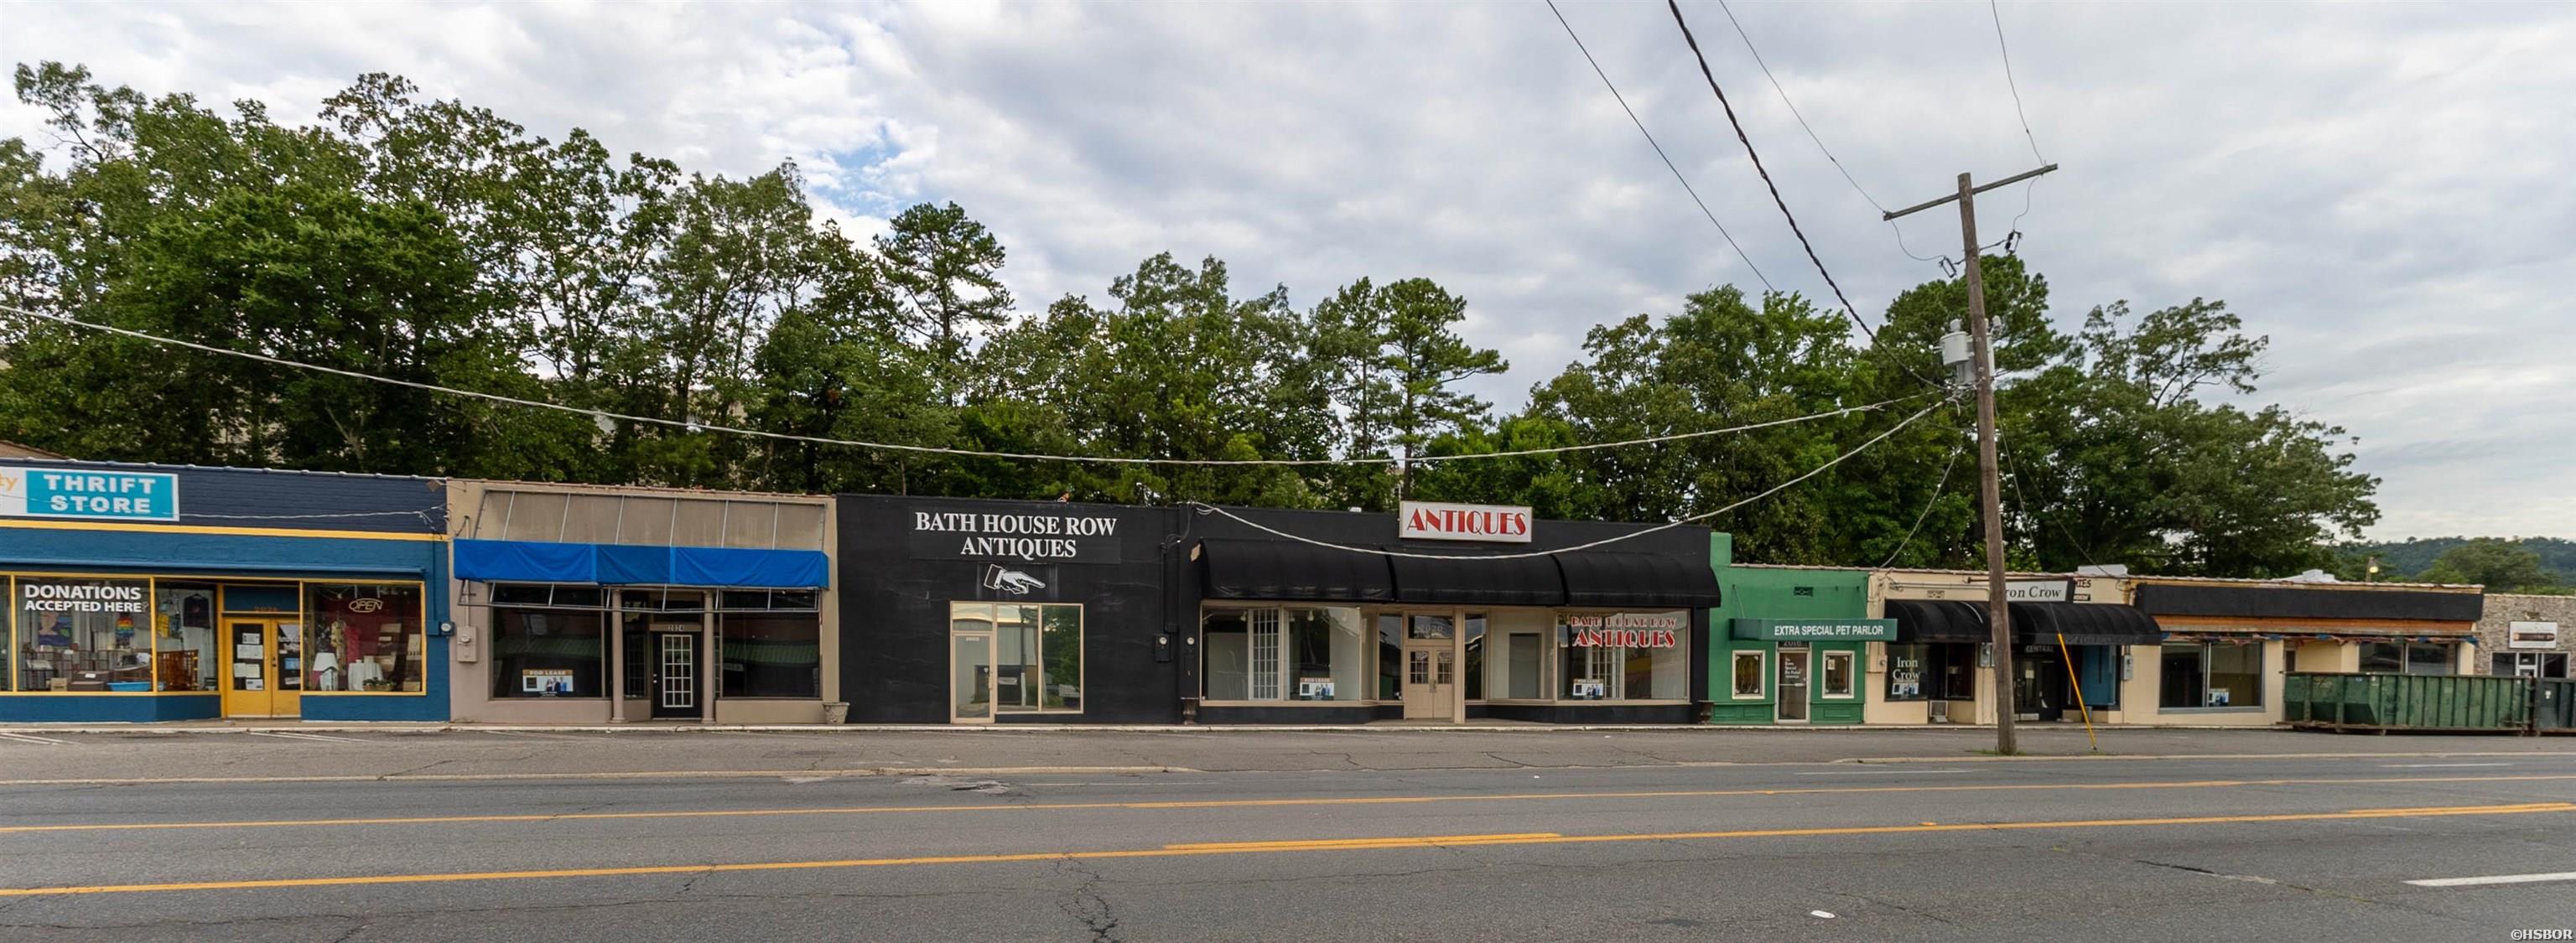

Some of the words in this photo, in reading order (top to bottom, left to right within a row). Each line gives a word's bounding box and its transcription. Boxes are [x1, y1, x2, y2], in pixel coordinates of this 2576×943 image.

[43, 474, 157, 495] THRIFT
[50, 495, 152, 514] STORE
[915, 511, 978, 532] BATH
[982, 514, 1061, 535] HOUSE
[1065, 516, 1118, 536] ROW
[1406, 507, 1528, 536] ANTIQUES
[960, 536, 1077, 561] ANTIQUES
[2075, 578, 2091, 588] IES
[24, 584, 141, 601] DONATIONS
[2005, 588, 2025, 598] ron
[2028, 586, 2062, 598] Crow
[24, 599, 101, 612] ACCEPTED
[104, 601, 143, 613] HERE
[349, 598, 384, 613] OPEN
[1571, 615, 1602, 627] BATH
[1605, 616, 1649, 628] HOUSE
[1650, 617, 1677, 629] ROW
[1774, 625, 1800, 635] EXTRA
[1801, 625, 1834, 635] SPECIAL
[1836, 625, 1852, 635] PET
[1852, 624, 1884, 635] PARLOR
[1572, 629, 1675, 648] ANTIQUES
[2025, 645, 2054, 653] CENTRAL
[1897, 656, 1919, 668] Iron
[1893, 669, 1920, 681] Crow
